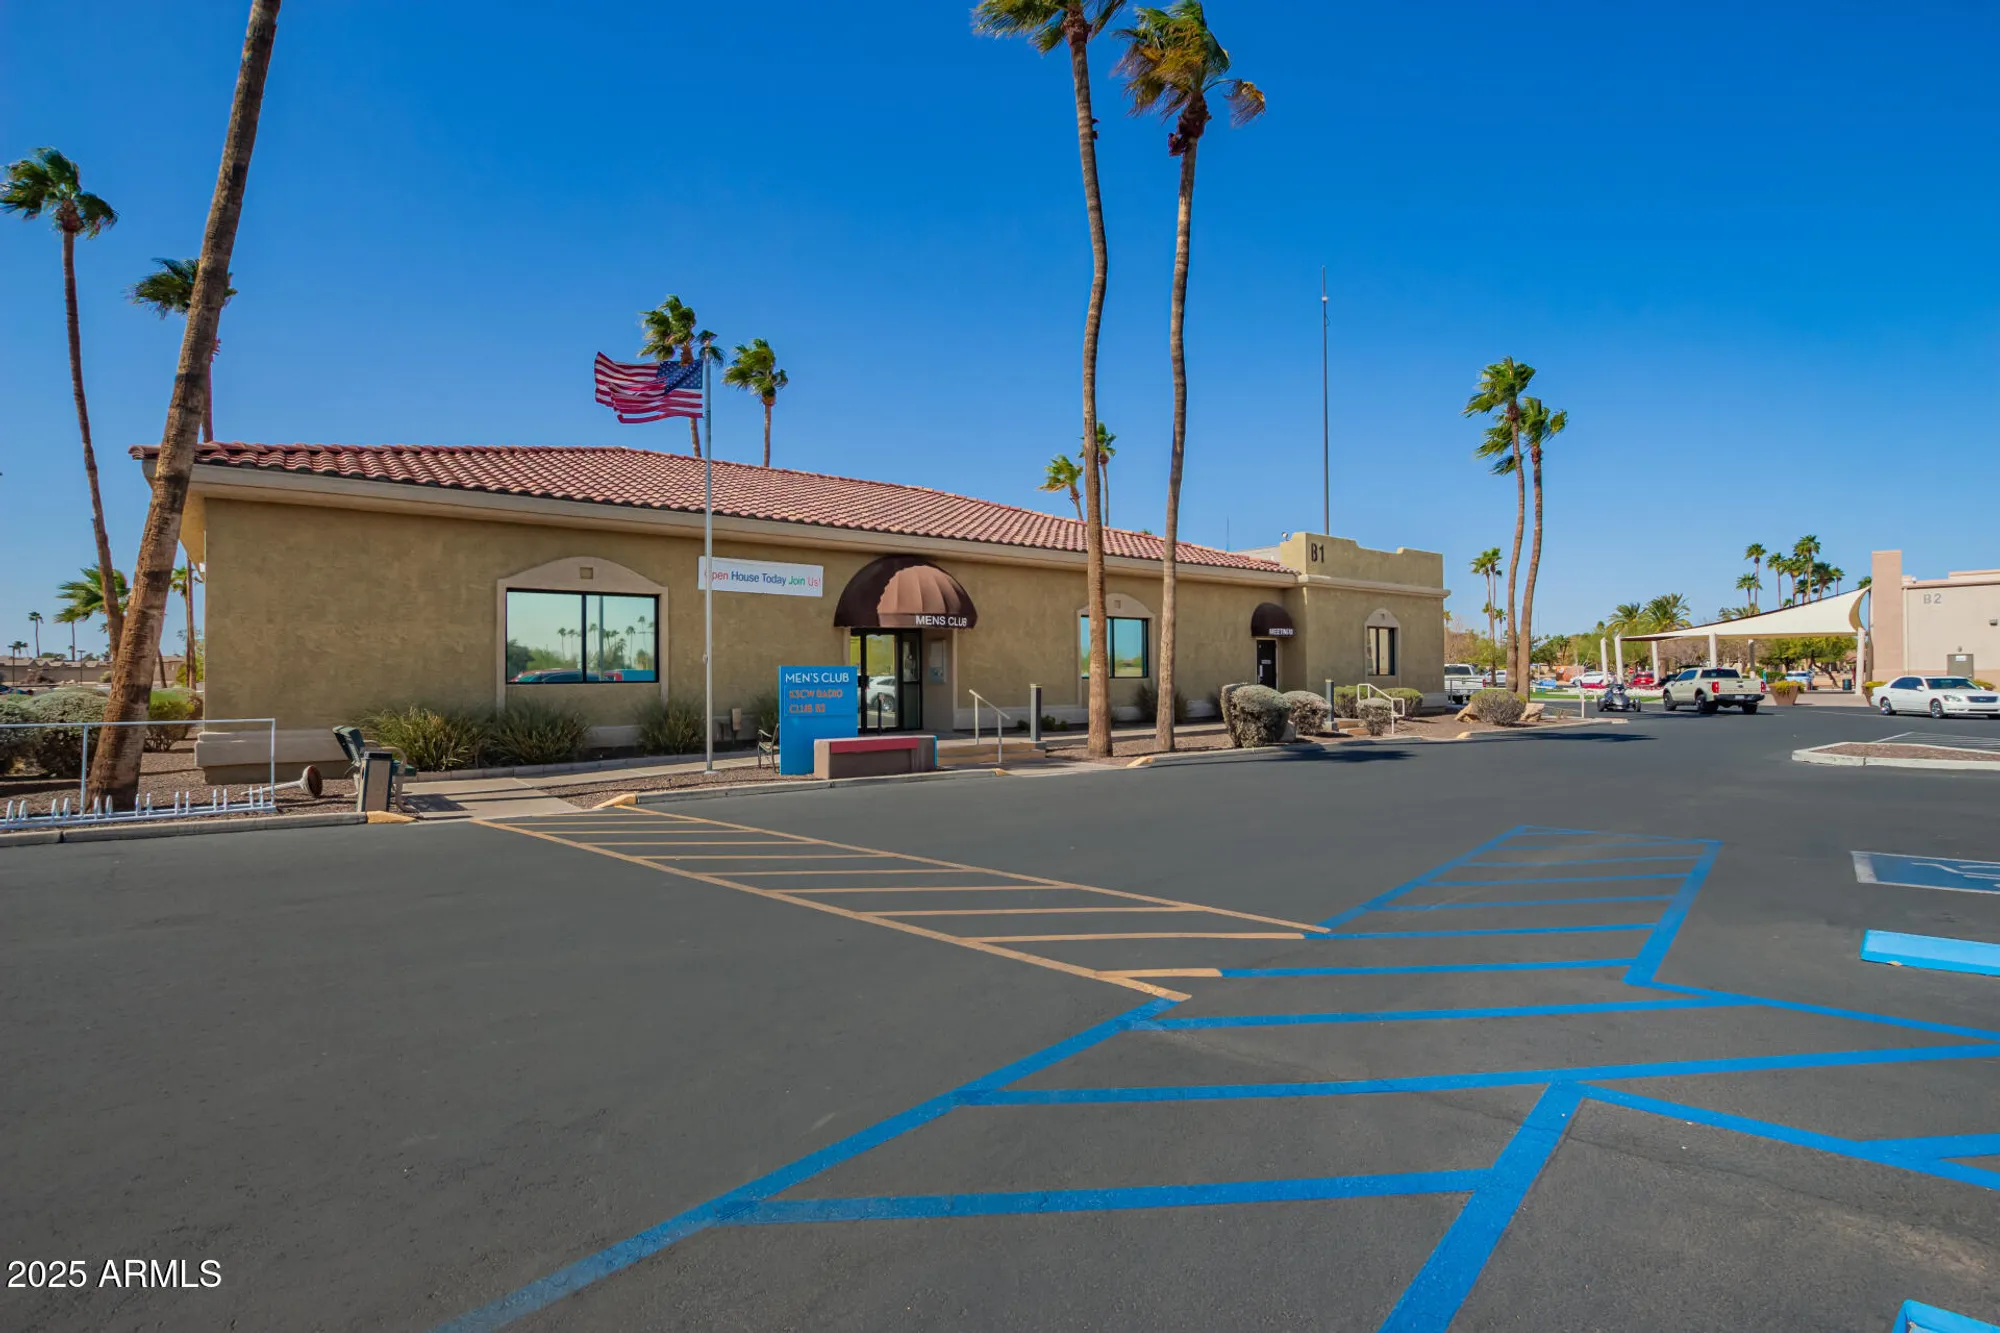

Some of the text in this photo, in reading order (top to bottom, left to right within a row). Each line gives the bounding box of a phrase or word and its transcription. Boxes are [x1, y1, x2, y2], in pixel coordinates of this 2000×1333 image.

[1311, 542, 1324, 564] B1
[704, 570, 729, 581] pen
[731, 571, 759, 583] House
[762, 572, 787, 586] Today
[788, 575, 805, 585] Join
[1923, 593, 1942, 604] B2
[915, 615, 968, 627] MENS CLUB
[785, 672, 850, 683] MEN'S CLUB
